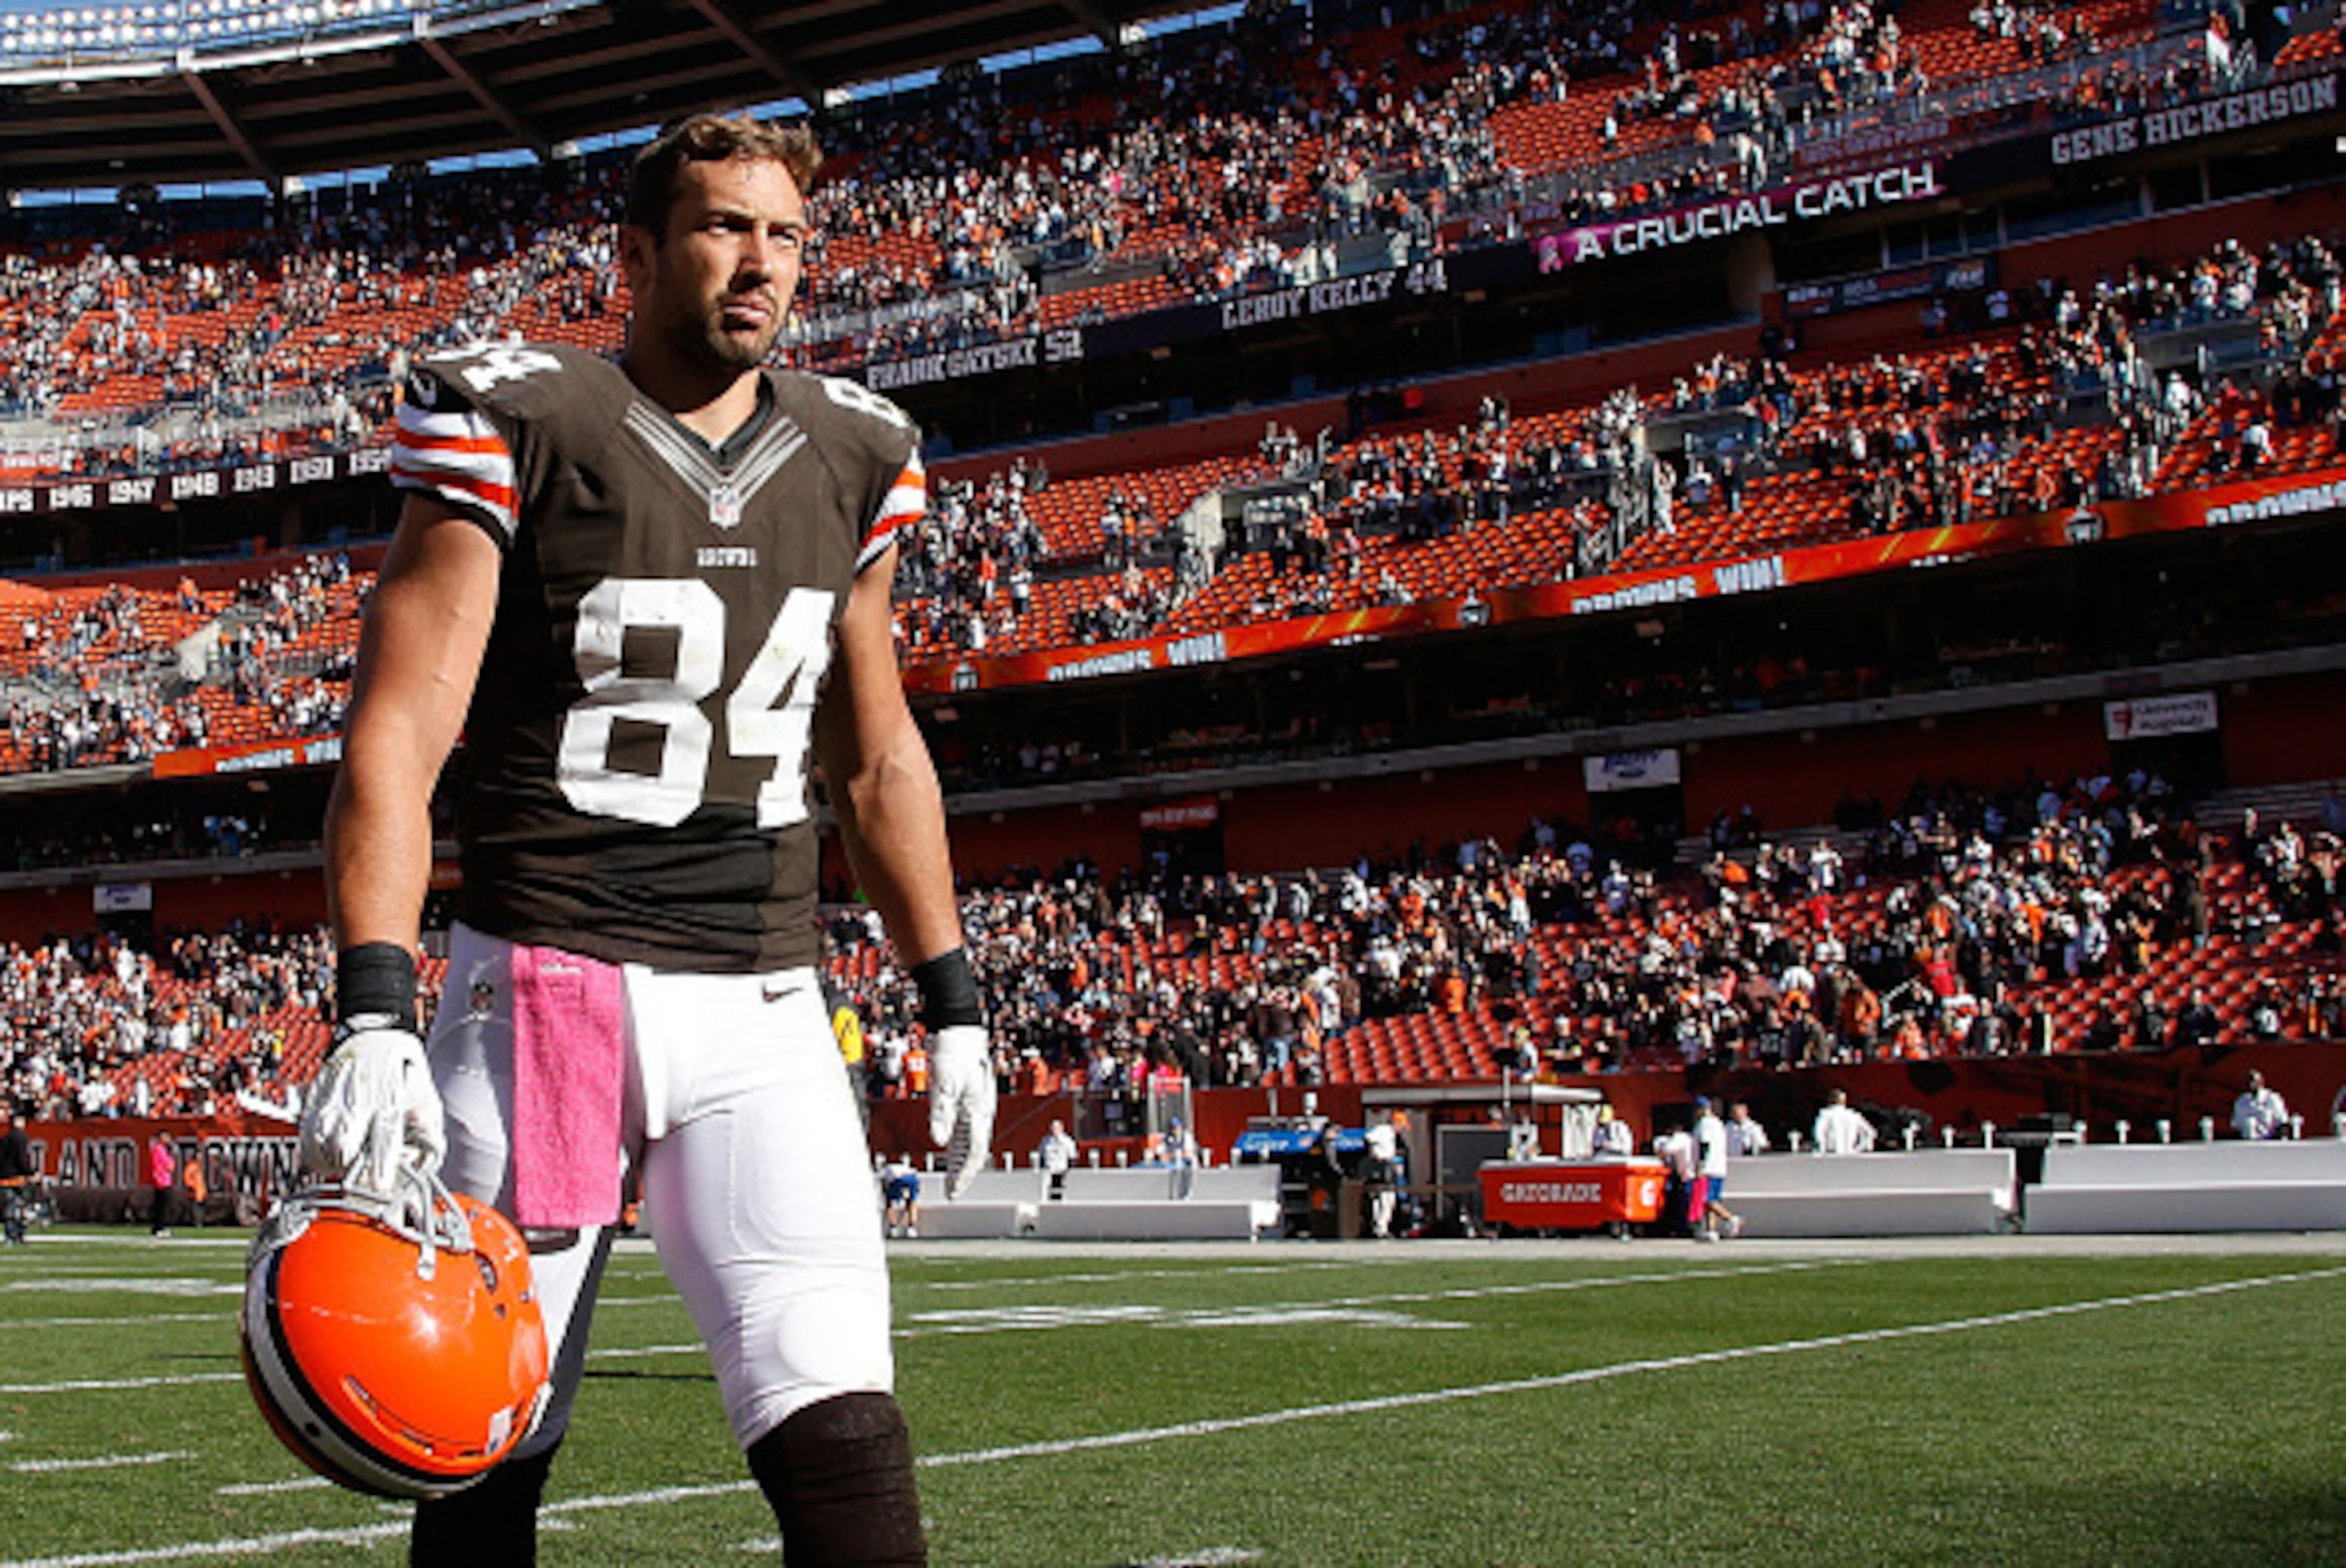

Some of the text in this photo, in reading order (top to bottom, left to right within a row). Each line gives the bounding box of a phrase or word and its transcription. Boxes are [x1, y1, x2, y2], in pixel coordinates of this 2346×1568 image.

[2052, 73, 2339, 165] GENE HICKERSON
[1574, 231, 1605, 262] A
[1613, 196, 1787, 255] CRUCIAL
[1795, 161, 1934, 217] CATCH
[1222, 258, 1448, 331] LEROY KELLY 44
[108, 477, 157, 504] 1947
[558, 577, 836, 830] 84
[27, 1136, 137, 1190] LAND
[1499, 1182, 1603, 1203] GATORADE
